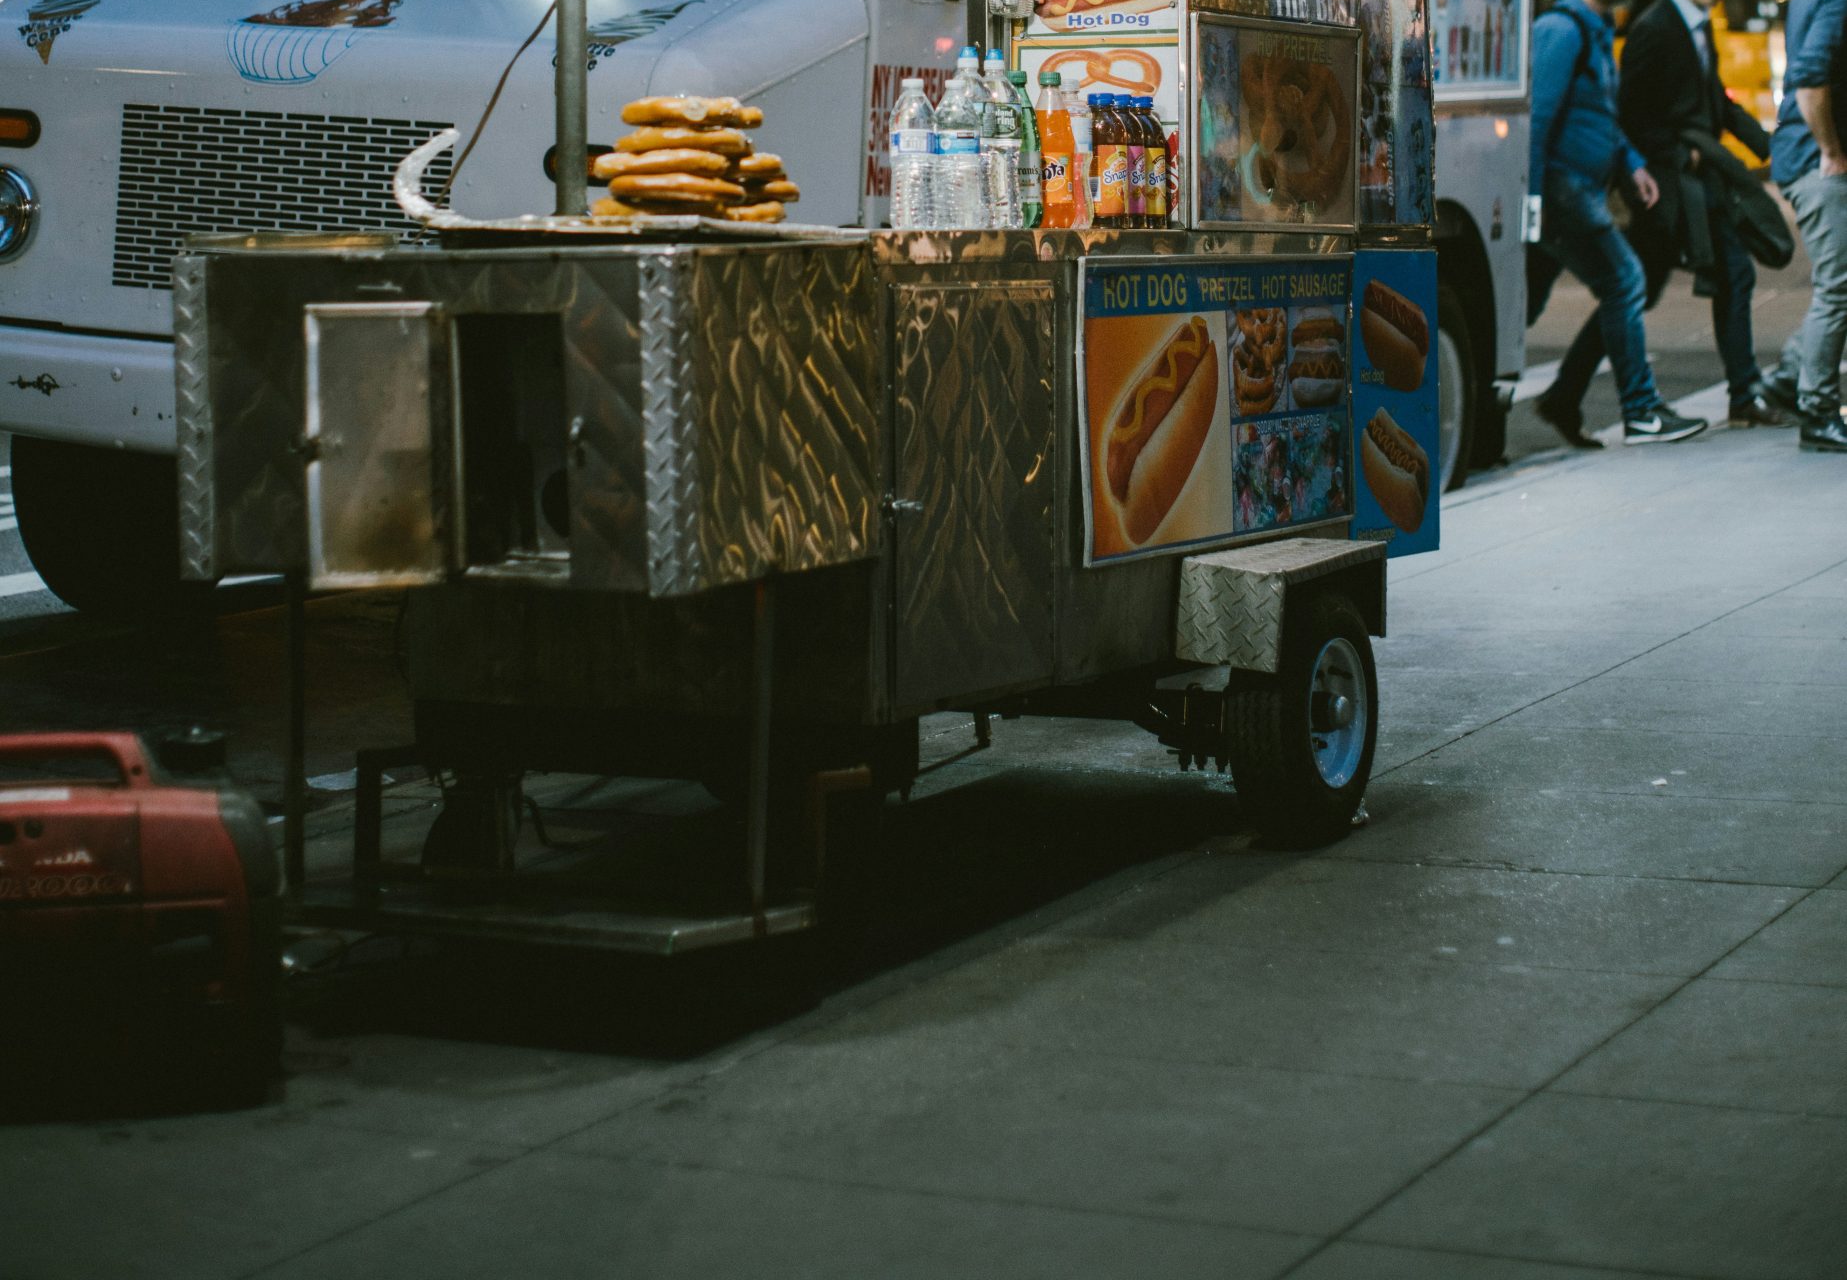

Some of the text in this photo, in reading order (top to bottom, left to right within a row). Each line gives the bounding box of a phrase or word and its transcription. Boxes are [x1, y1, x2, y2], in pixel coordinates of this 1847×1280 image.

[26, 23, 71, 47] Cone
[1068, 13, 1150, 27] Hot Dog
[1256, 31, 1333, 64] HOT PRETZEL
[1386, 131, 1395, 206] Gatorade
[1103, 273, 1345, 309] HOT DOG PRETZEL HOT SAUSAGE
